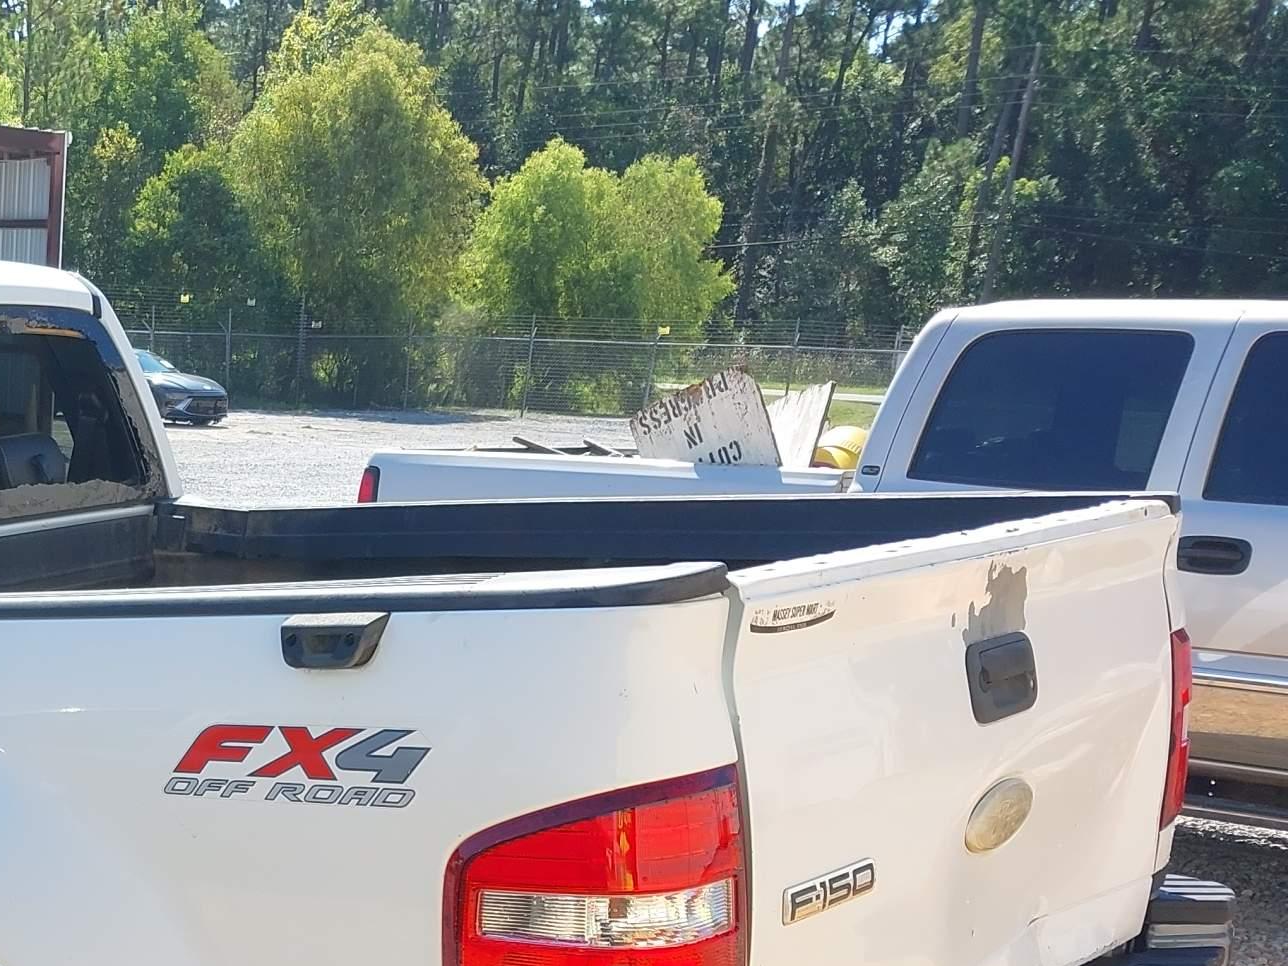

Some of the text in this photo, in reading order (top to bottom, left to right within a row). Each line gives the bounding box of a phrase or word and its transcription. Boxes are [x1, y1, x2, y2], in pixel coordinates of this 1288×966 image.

[683, 423, 703, 449] IN
[173, 724, 432, 784] FX4
[164, 777, 416, 808] OFF ROAD
[789, 862, 875, 922] F-150
